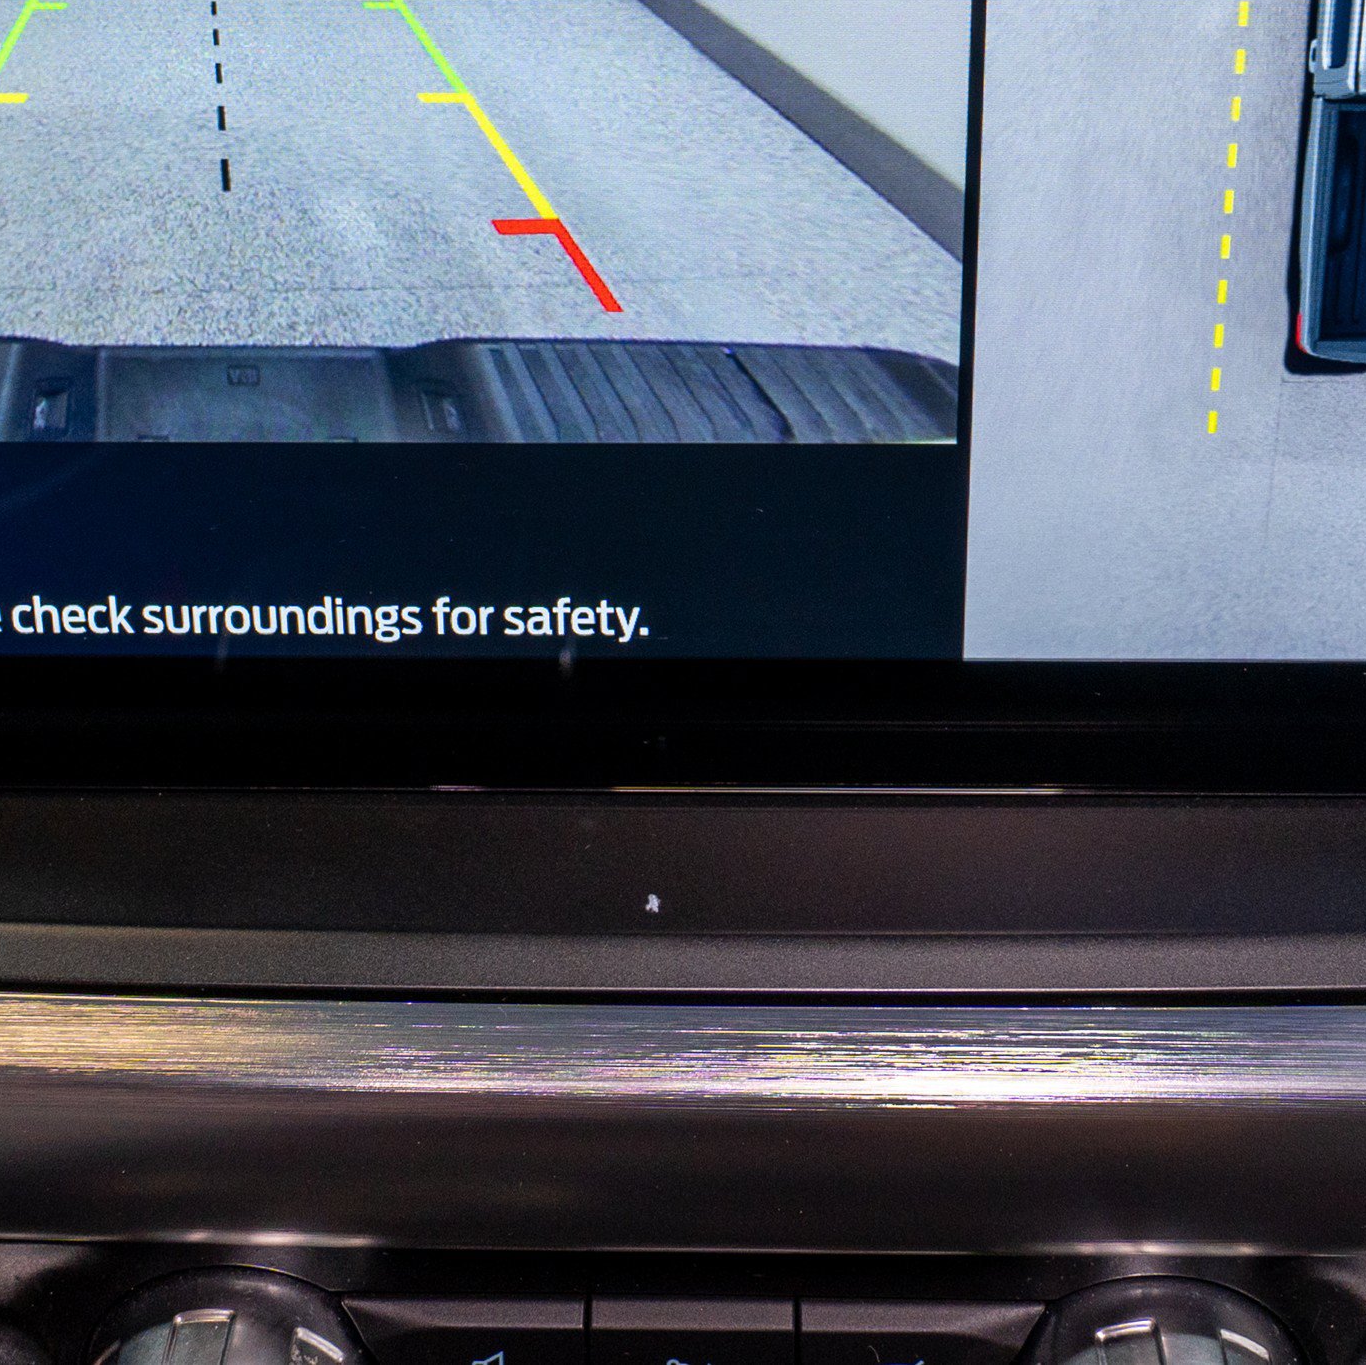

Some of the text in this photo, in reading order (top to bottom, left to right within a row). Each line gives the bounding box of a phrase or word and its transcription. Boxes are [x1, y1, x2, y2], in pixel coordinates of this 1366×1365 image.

[11, 594, 134, 635] check
[141, 595, 423, 643] surroundings
[432, 595, 495, 636] for
[503, 596, 650, 643] safety.
